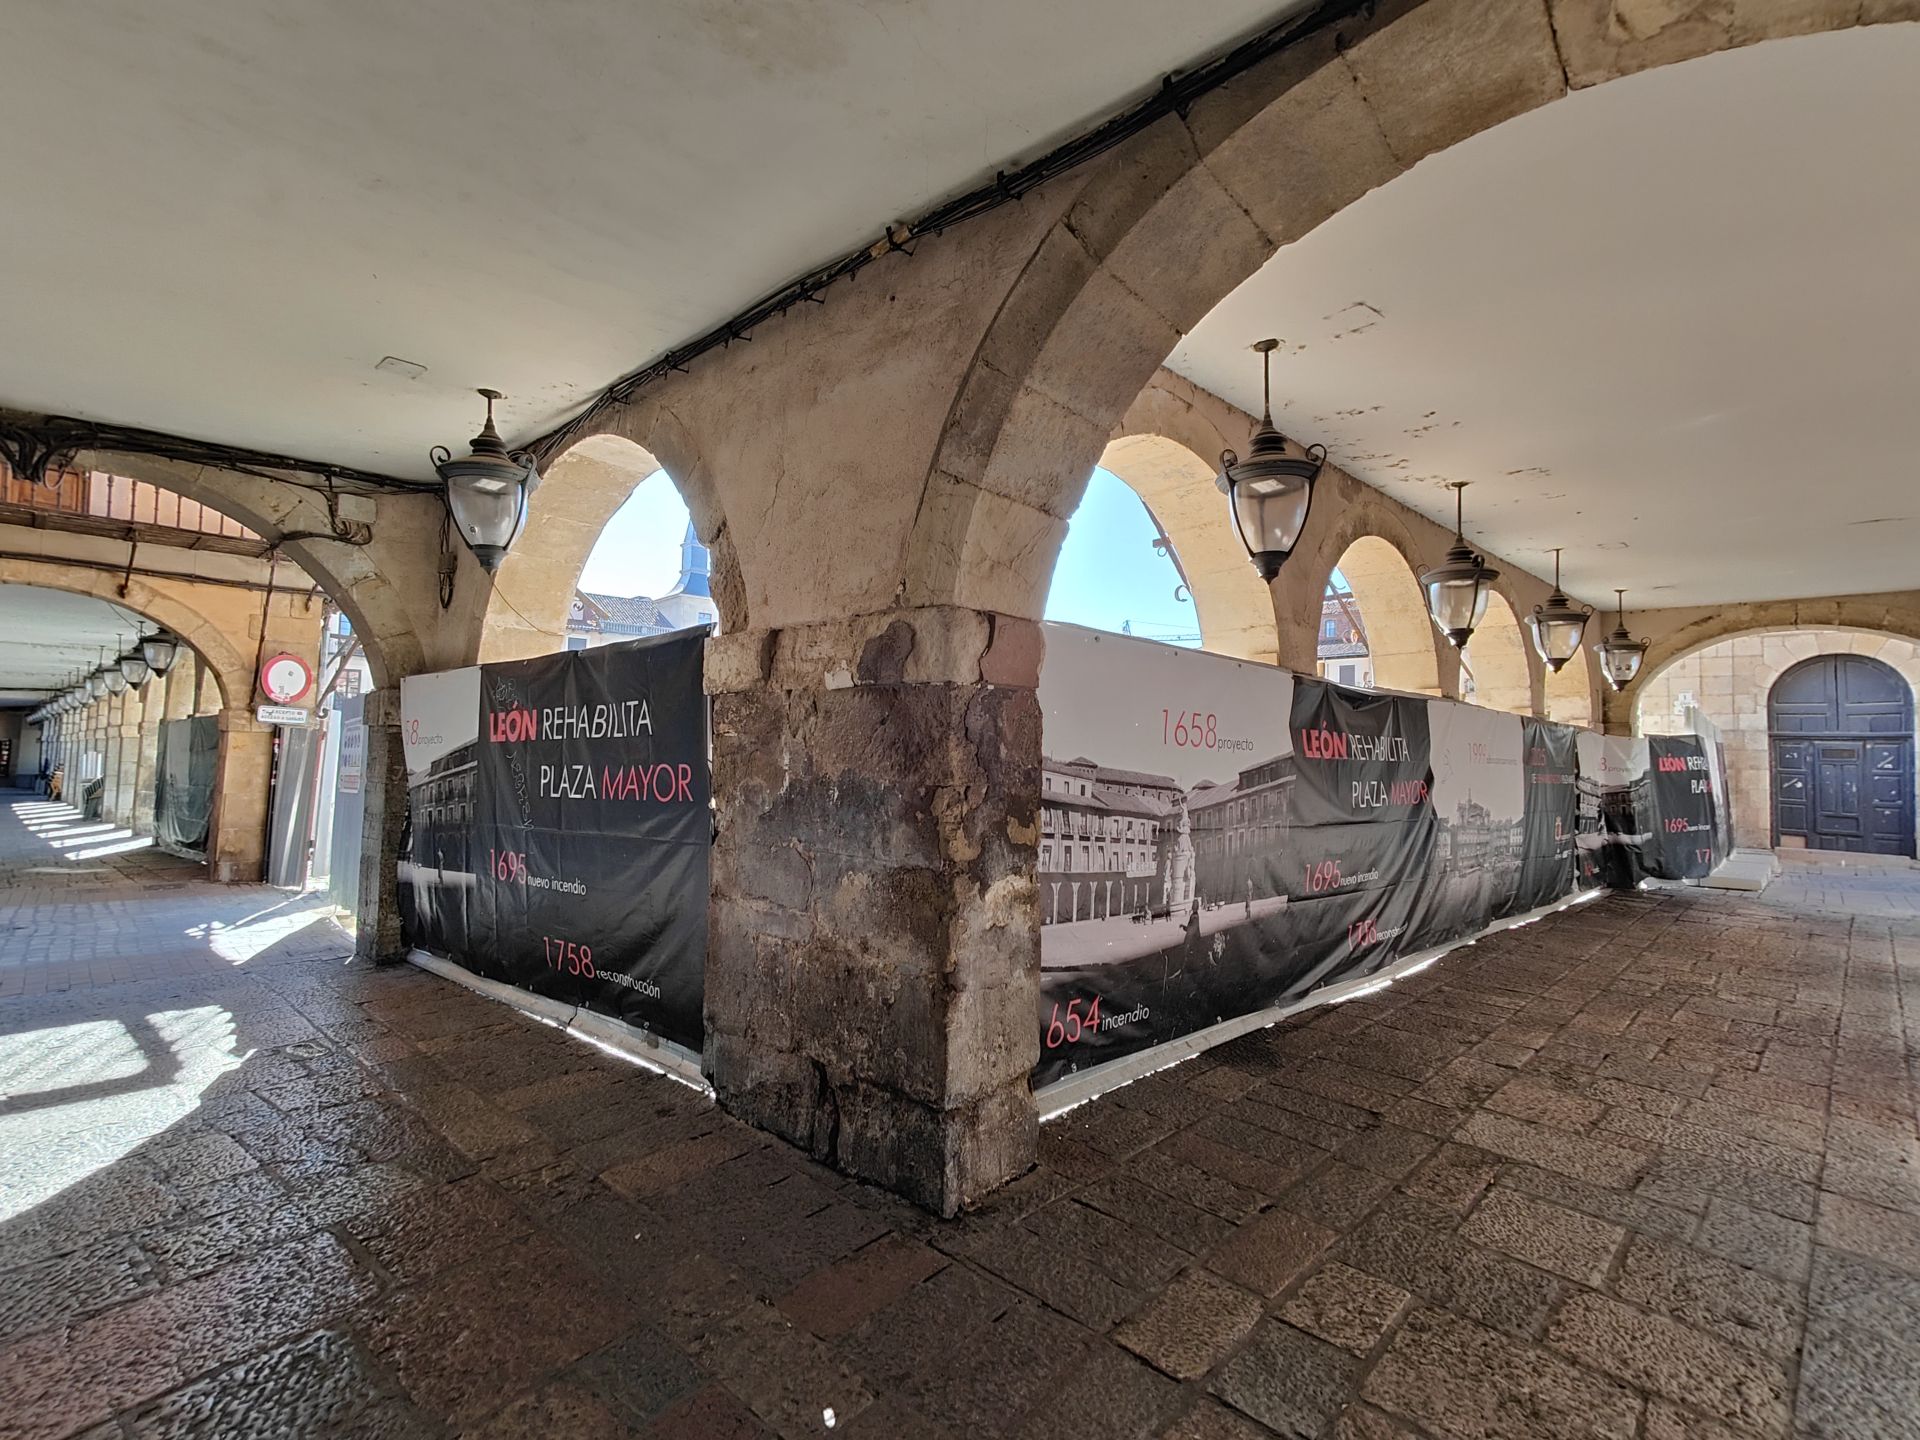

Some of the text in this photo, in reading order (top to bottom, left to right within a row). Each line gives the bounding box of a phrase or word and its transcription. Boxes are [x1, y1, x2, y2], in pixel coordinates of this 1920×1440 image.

[489, 699, 653, 743] LEÓN REHABILITA
[1162, 709, 1254, 753] 1658 proyecto
[1302, 720, 1411, 762] LEÓN REHABILITA
[540, 764, 597, 799] PLAZA
[602, 763, 694, 802] MAYOR
[1352, 780, 1431, 808] PLAZA MAYOR
[1664, 818, 1690, 833] 1695
[490, 849, 587, 896] 1695 nuevo incendio
[1304, 860, 1379, 892] 1695 nuevo incendio
[543, 936, 661, 999] 1758 reconstrucción
[1046, 994, 1150, 1049] 654 incendio
